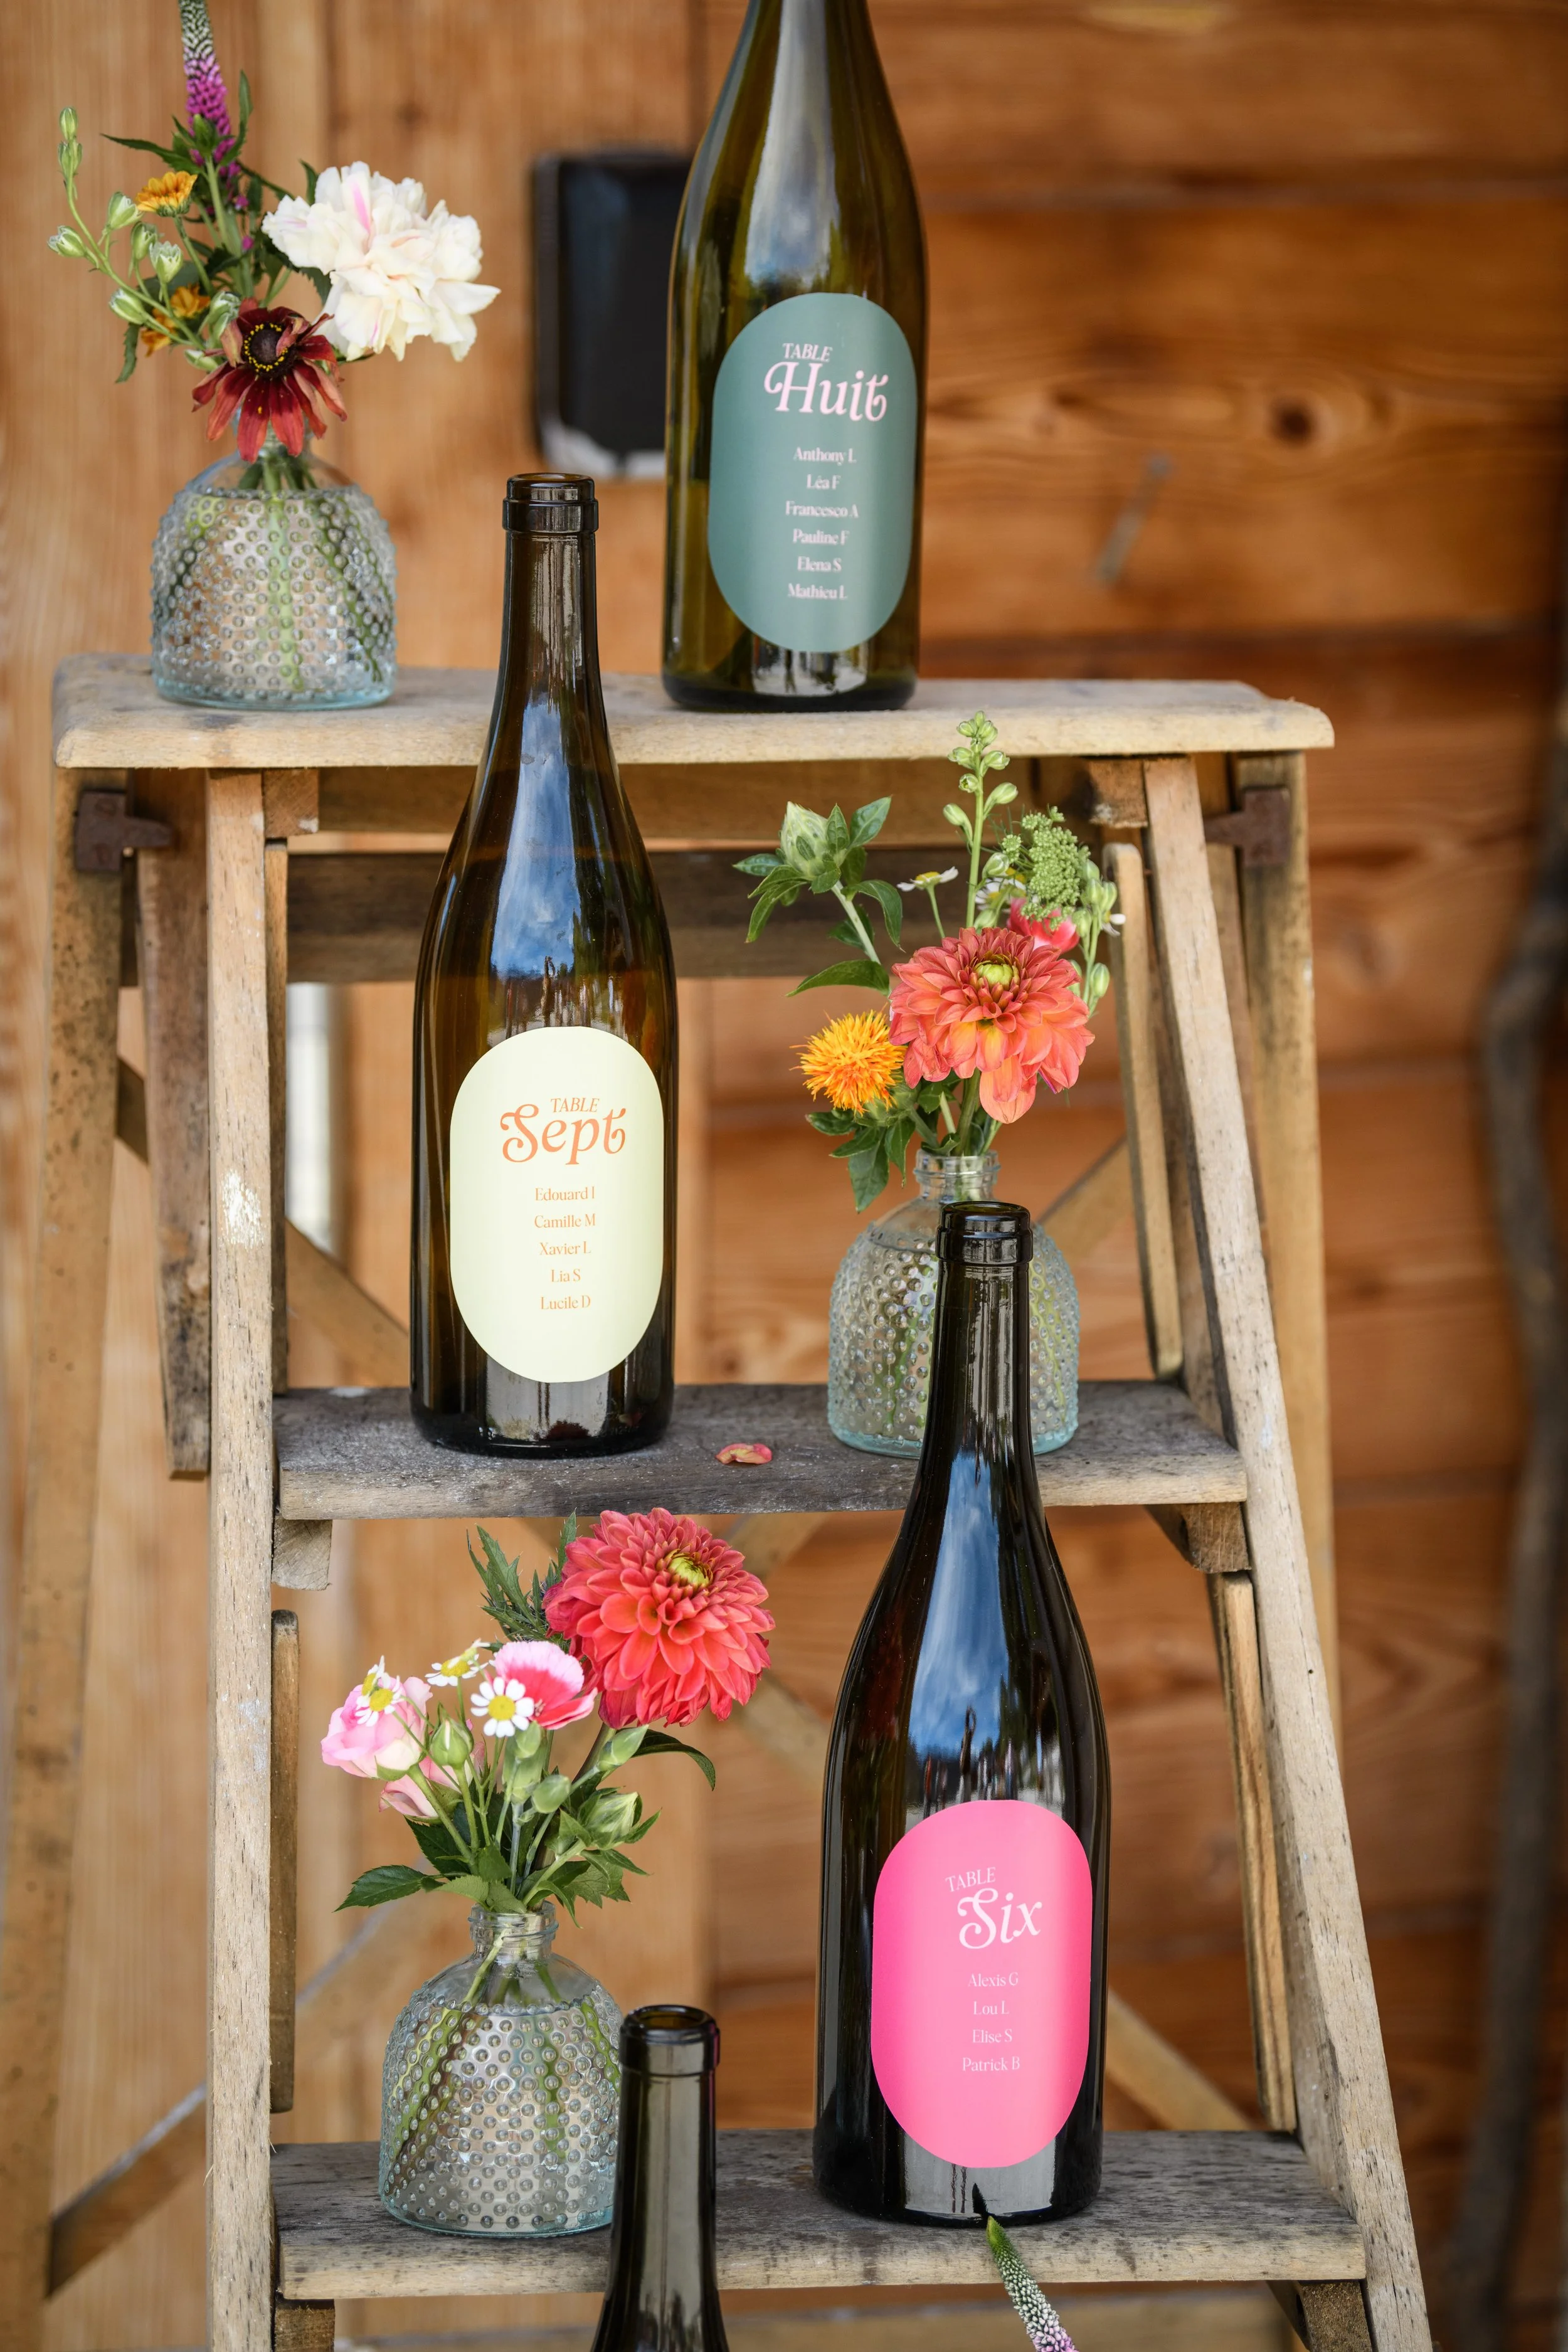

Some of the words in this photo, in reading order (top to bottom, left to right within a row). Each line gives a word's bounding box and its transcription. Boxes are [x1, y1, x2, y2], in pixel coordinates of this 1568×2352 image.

[783, 342, 833, 363] TABLE
[763, 361, 889, 421] Huit
[793, 447, 844, 466] Anthony
[848, 448, 857, 464] L
[832, 475, 842, 490] F
[786, 501, 849, 517] Francesco
[849, 504, 859, 518] A
[793, 528, 839, 545] Pauline
[840, 530, 850, 546] F
[797, 556, 832, 572] Elena
[833, 558, 842, 573] S
[788, 583, 838, 600] Mathieu
[839, 585, 849, 600] L
[550, 1097, 600, 1113] TABLE
[500, 1103, 627, 1165] Sept
[535, 1186, 588, 1201] Edouard
[534, 1214, 582, 1228] Camille
[585, 1213, 596, 1227] M
[539, 1241, 580, 1256] Xavier
[583, 1241, 591, 1254] L
[551, 1269, 570, 1283] Lia
[573, 1268, 581, 1282] S
[541, 1296, 579, 1310] Lucile
[582, 1295, 591, 1308] D
[945, 1867, 996, 1892] TABLE
[956, 1887, 1042, 1949] Six
[968, 1973, 1006, 1987] Alexis
[1009, 1972, 1019, 1986] G
[973, 2000, 998, 2015] Lou
[1001, 2000, 1010, 2015] L
[973, 2028, 1002, 2043] Elise
[1005, 2028, 1012, 2042] S
[963, 2057, 1008, 2071] Patrick
[1012, 2055, 1020, 2070] B
